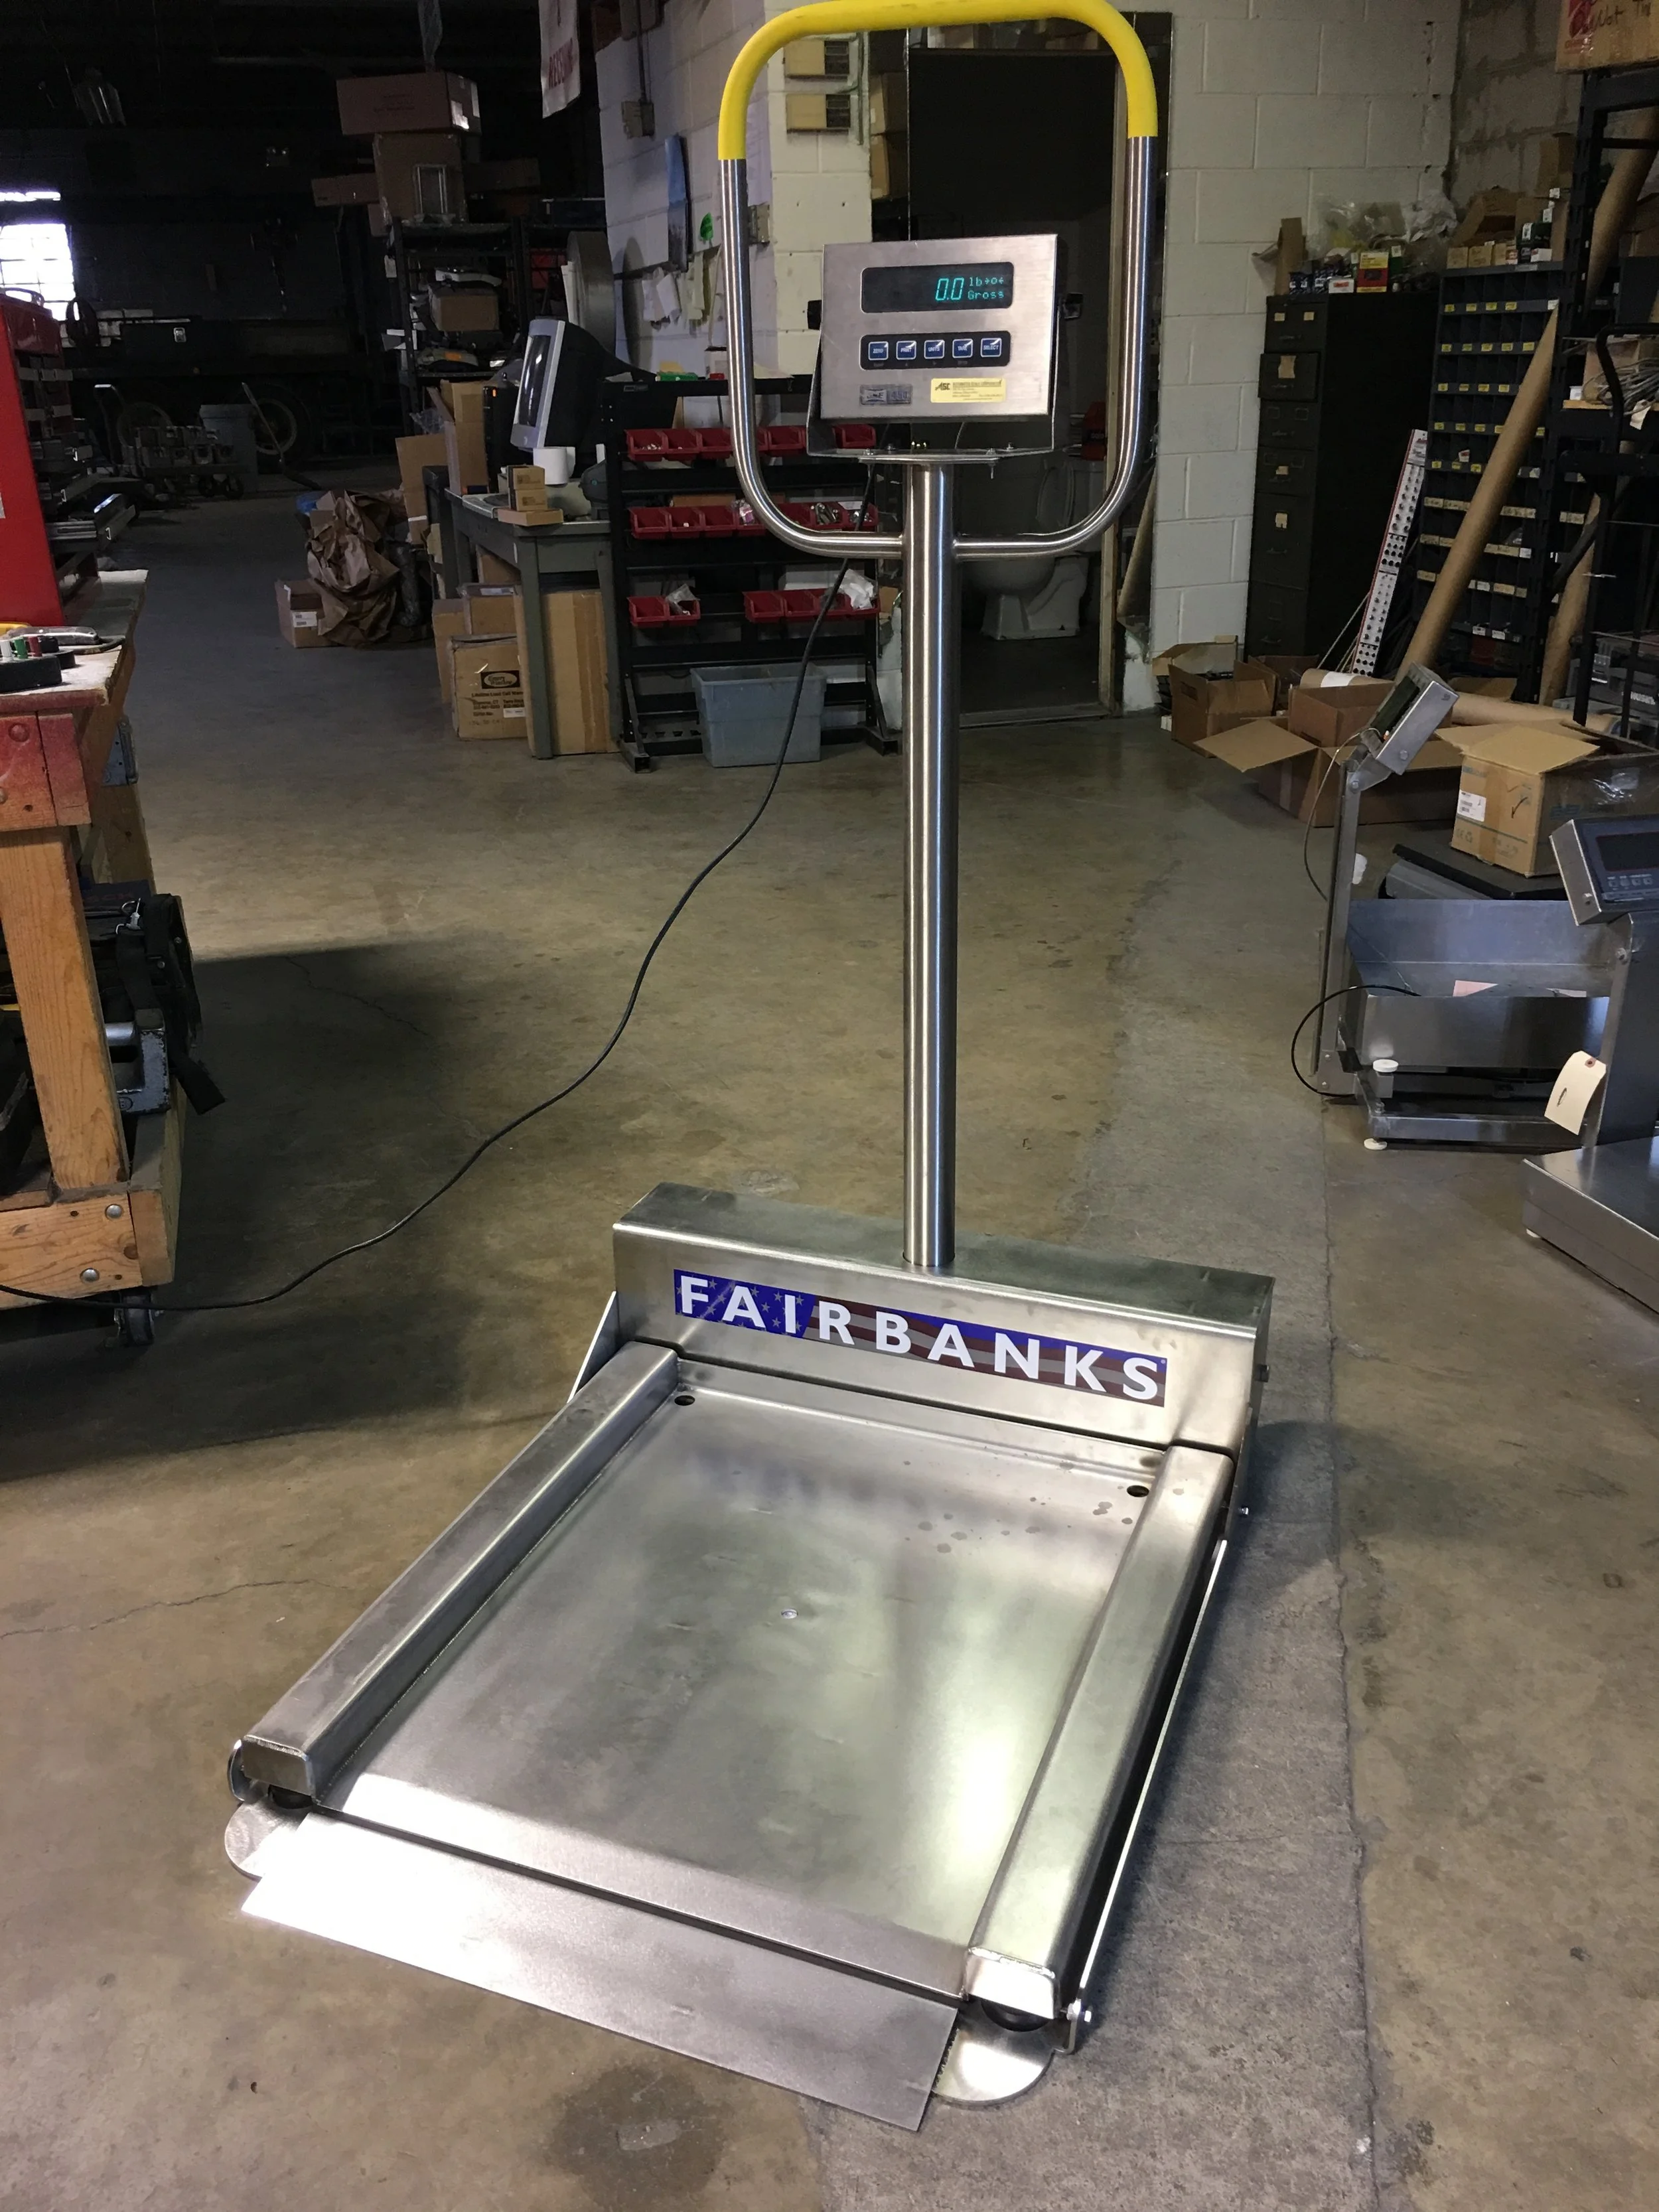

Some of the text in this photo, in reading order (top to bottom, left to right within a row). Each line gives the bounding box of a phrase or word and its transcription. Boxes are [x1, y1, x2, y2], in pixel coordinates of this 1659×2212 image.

[934, 277, 982, 301] 0.0 lb
[967, 290, 1004, 301] Gross
[681, 1275, 1159, 1400] FAIRBANKS
